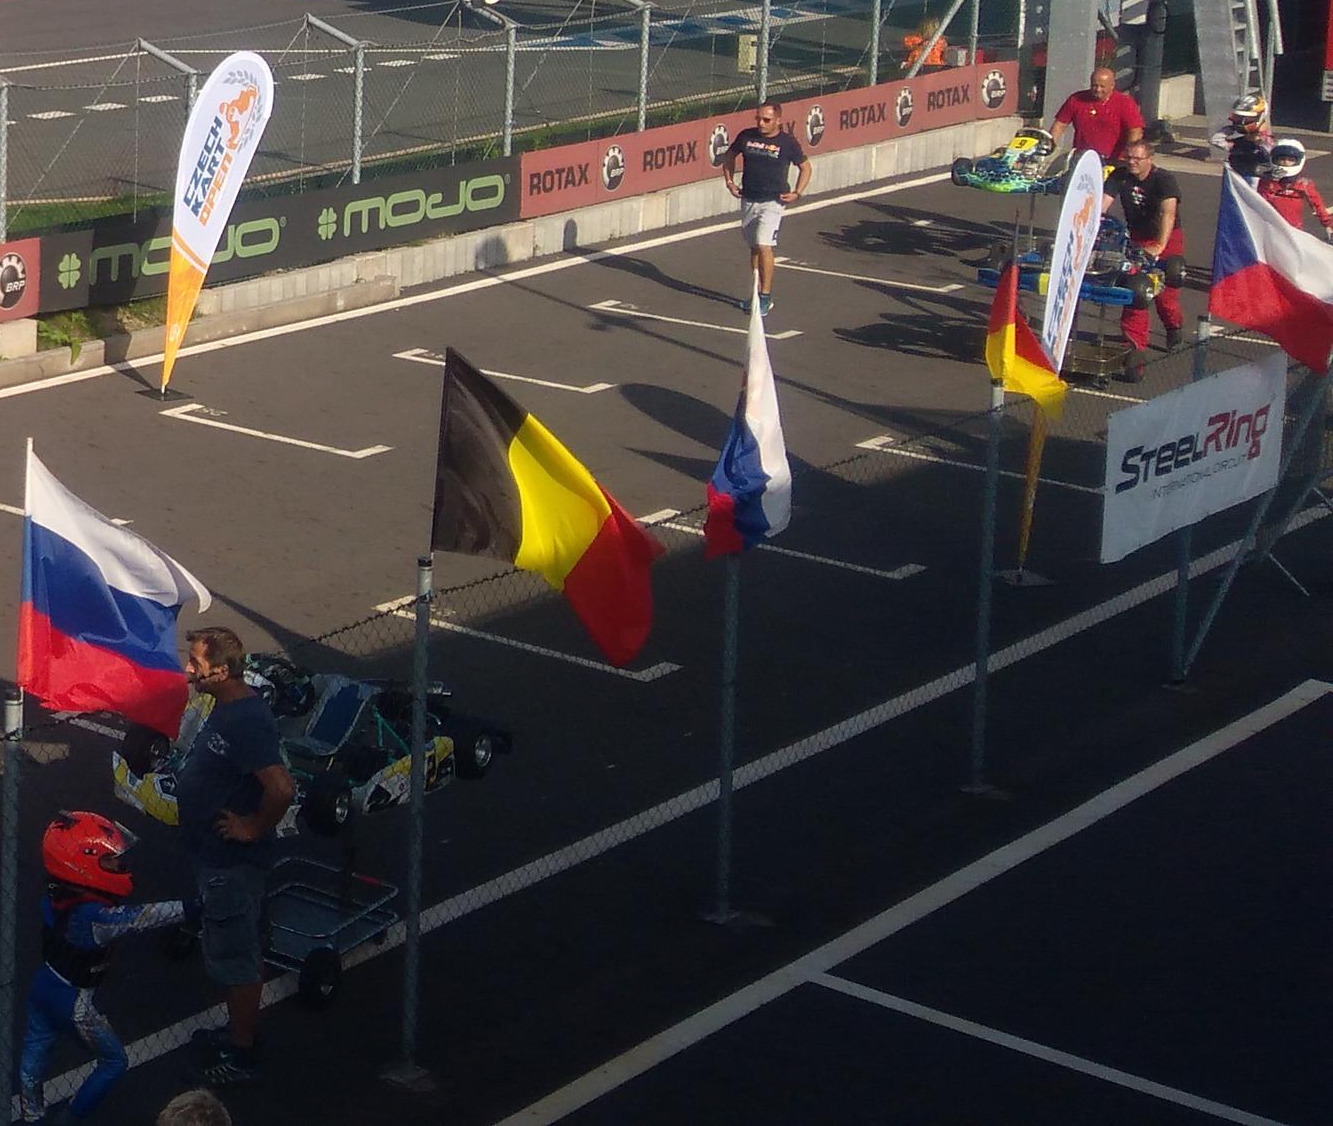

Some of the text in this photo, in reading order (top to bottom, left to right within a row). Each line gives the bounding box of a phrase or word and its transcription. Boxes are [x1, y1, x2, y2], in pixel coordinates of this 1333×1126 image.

[928, 82, 970, 111] ROTAX
[839, 102, 886, 130] ROTAX
[183, 116, 224, 207] CZECH
[643, 141, 698, 171] ROTAX
[192, 140, 226, 217] KART
[199, 153, 233, 227] OPEN
[529, 163, 589, 196] ROTAX
[6, 279, 27, 293] BRP
